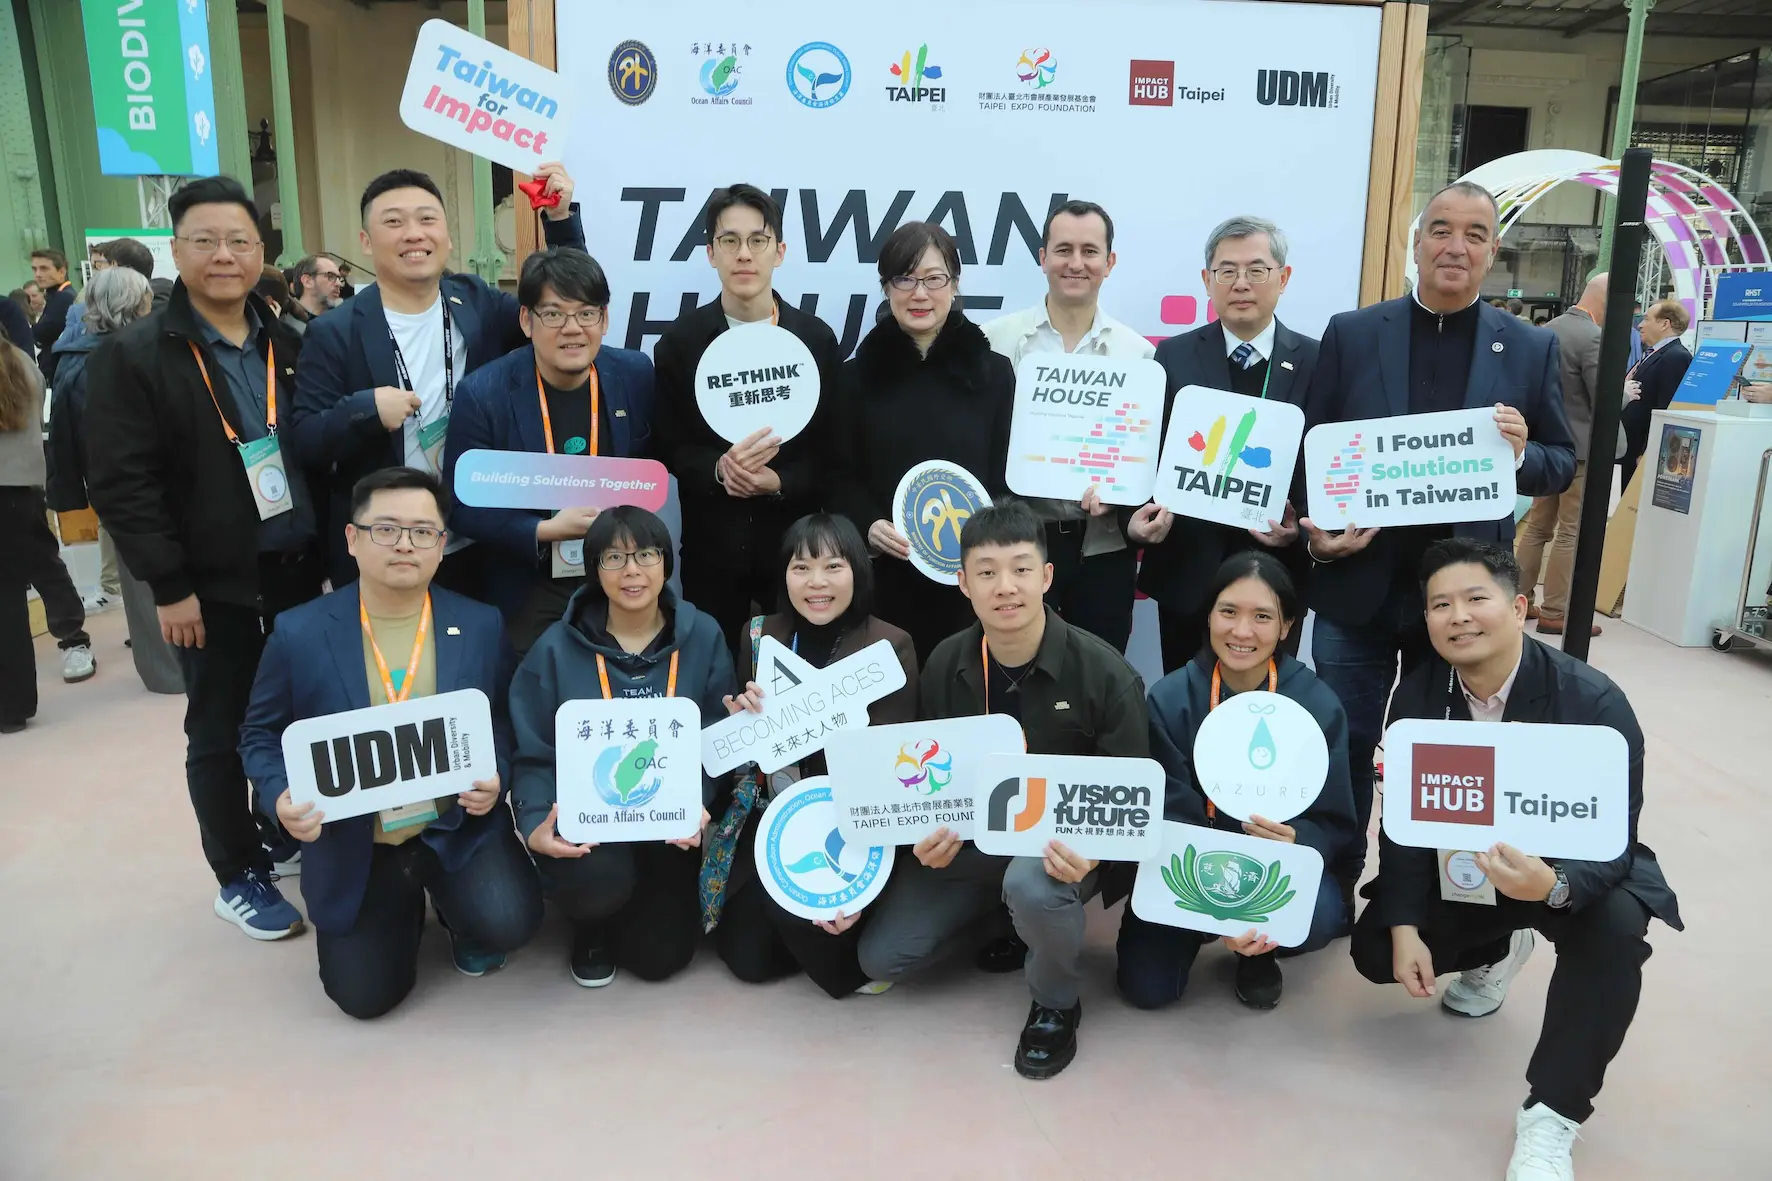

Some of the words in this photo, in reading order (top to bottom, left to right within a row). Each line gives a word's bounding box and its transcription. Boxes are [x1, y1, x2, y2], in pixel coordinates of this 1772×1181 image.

[723, 65, 742, 74] OAC
[436, 44, 558, 119] Taiwan
[1134, 85, 1168, 99] HUB
[1135, 77, 1169, 85] IMPACT
[1256, 69, 1329, 108] UDM
[477, 93, 508, 115] for
[691, 97, 709, 105] Ocean
[710, 97, 729, 105] Affairs
[731, 97, 752, 105] Council
[886, 86, 945, 103] TAIPEI
[1178, 86, 1225, 103] Taipei
[979, 102, 1006, 110] TAIPEI
[1011, 103, 1034, 111] EXPO
[1038, 103, 1096, 113] FOUNDATION
[423, 85, 548, 155] Impact
[1036, 366, 1127, 388] TAIWAN
[729, 385, 791, 407] 重新思考
[1032, 387, 1112, 407] HOUSE
[1377, 436, 1384, 452] I
[1392, 427, 1474, 451] Found
[1371, 456, 1494, 480] Solutions
[471, 472, 530, 486] Building
[532, 475, 596, 488] Solutions
[600, 478, 657, 491] Together
[1174, 465, 1272, 508] TAIPEI
[1365, 489, 1389, 508] in
[1396, 482, 1499, 506] Taiwan!
[623, 686, 653, 696] TEAM
[713, 692, 826, 760] BECOMING
[831, 662, 885, 704] ACES
[449, 717, 459, 747] Diversity
[577, 719, 684, 741] 海洋委員會
[771, 712, 848, 758] 未來大人物
[310, 717, 450, 797] UDM
[461, 732, 471, 761] Mobility
[450, 748, 461, 771] Urban
[634, 757, 668, 770] OAC
[1212, 783, 1309, 798] AZURE
[1421, 773, 1485, 787] IMPACT
[1420, 787, 1485, 812] HUB
[1504, 791, 1598, 822] Taipei
[578, 812, 609, 824] Ocean
[613, 810, 645, 824] Affairs
[650, 808, 686, 821] Council
[853, 818, 890, 830] TAIPEI
[898, 814, 929, 827] EXPO
[1053, 801, 1150, 828] future
